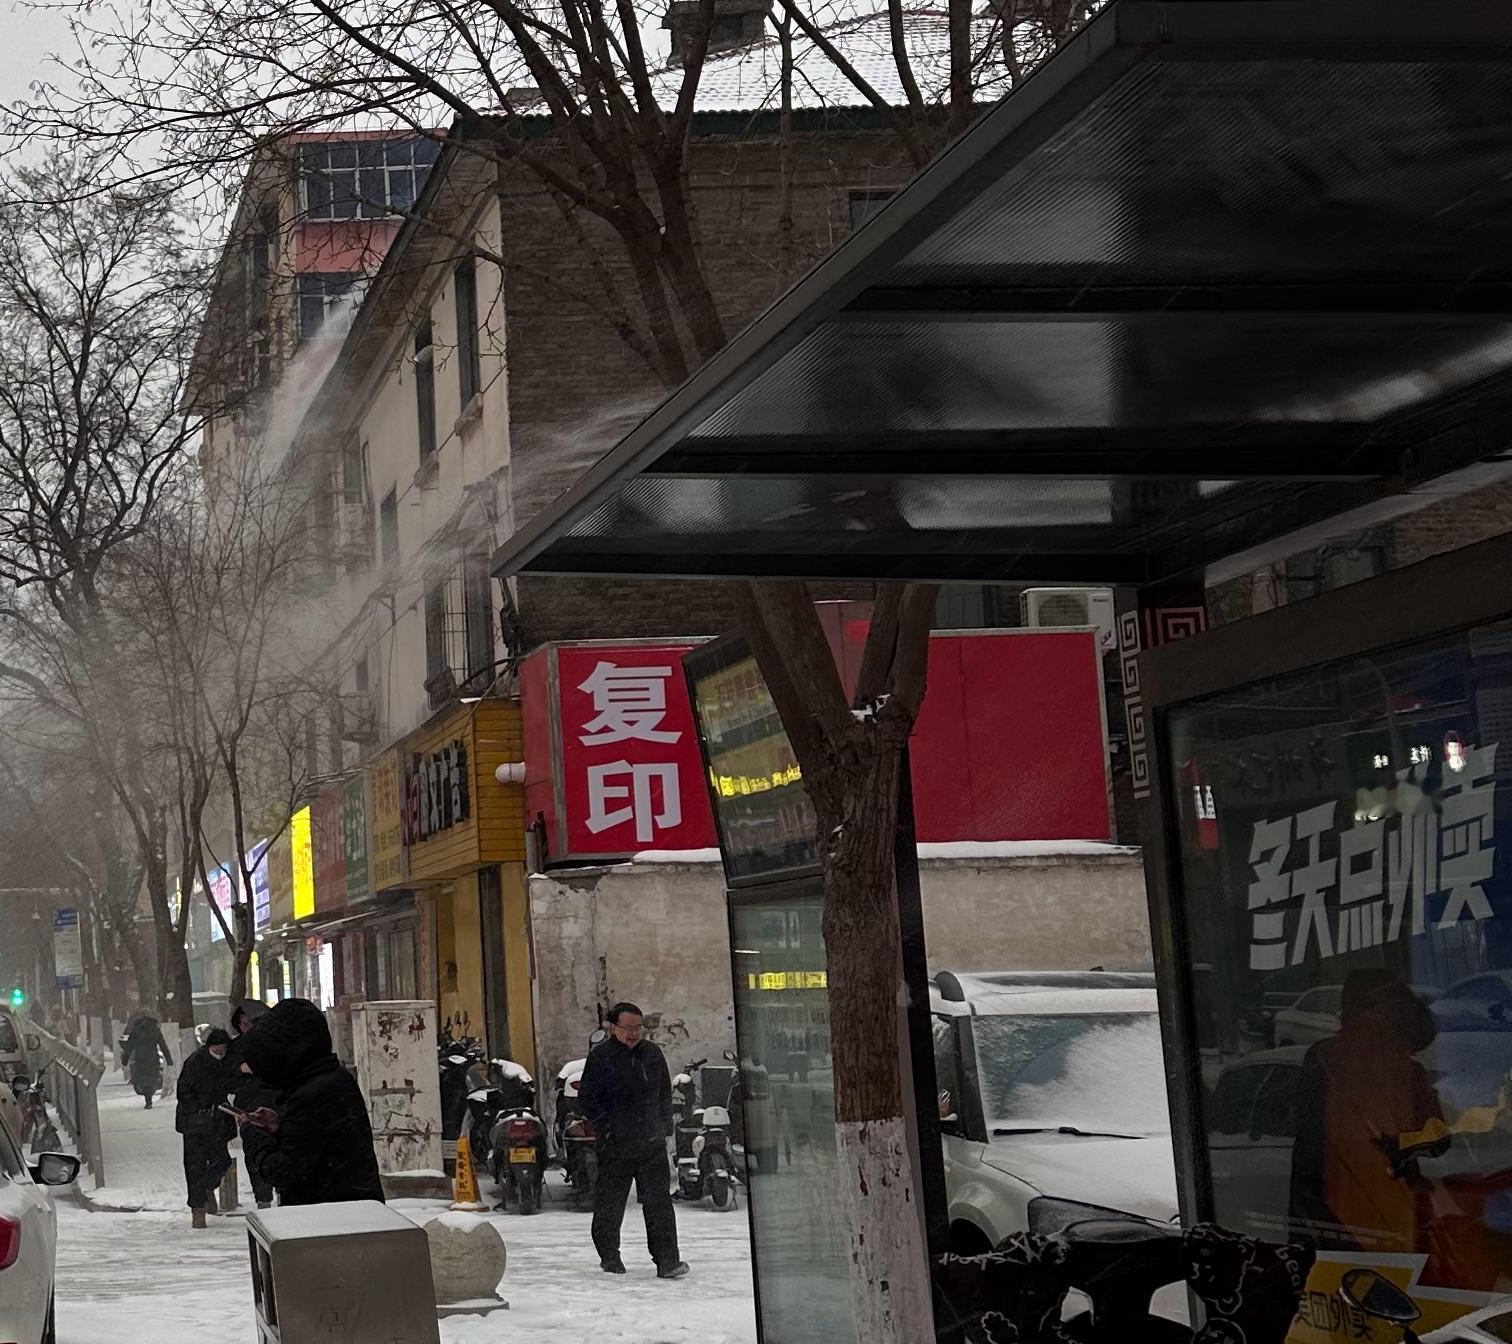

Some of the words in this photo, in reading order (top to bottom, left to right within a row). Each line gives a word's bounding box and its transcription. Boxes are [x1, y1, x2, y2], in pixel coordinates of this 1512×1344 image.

[577, 661, 682, 842] 复印
[1248, 743, 1500, 970] 冬天点外卖
